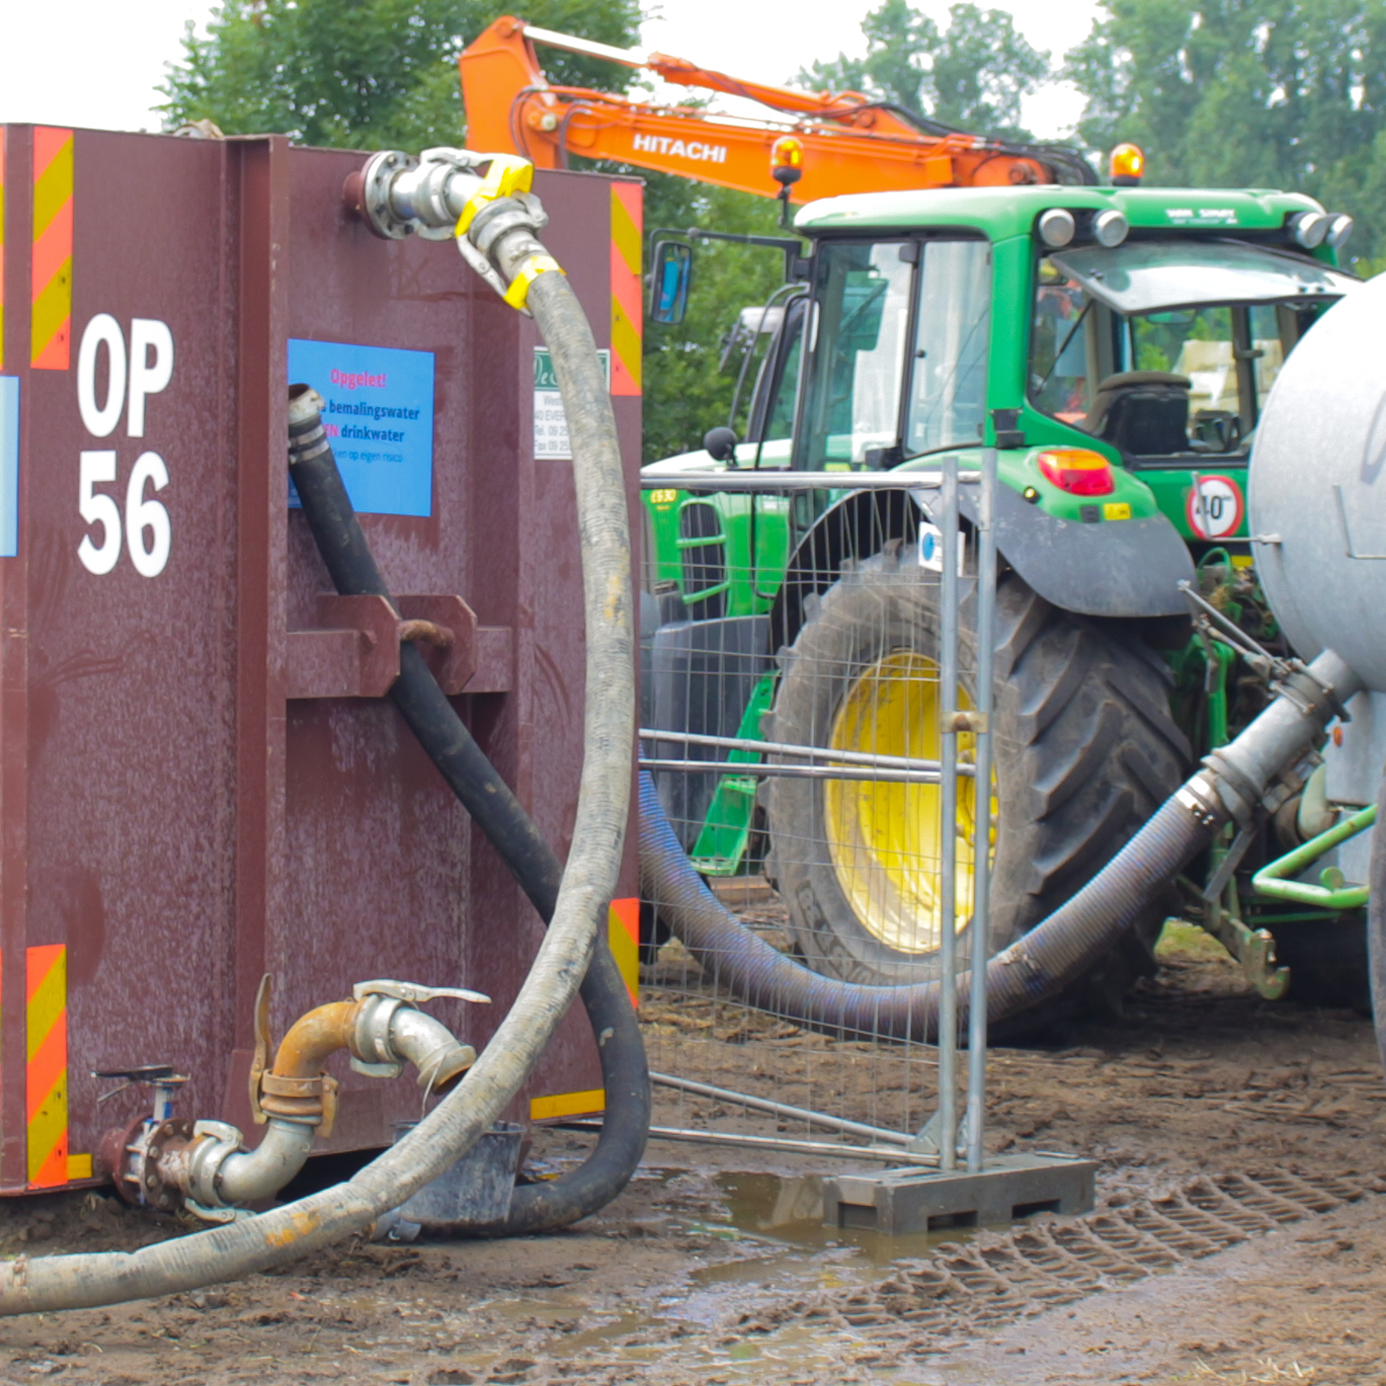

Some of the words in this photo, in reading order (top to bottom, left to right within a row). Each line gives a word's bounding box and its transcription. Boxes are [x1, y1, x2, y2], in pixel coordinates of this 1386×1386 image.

[633, 133, 727, 163] HITACHI
[77, 313, 174, 438] OP
[330, 369, 386, 390] Opgelet!
[329, 400, 420, 420] bemalingswater
[341, 424, 404, 442] drinkwater
[77, 450, 172, 577] 56
